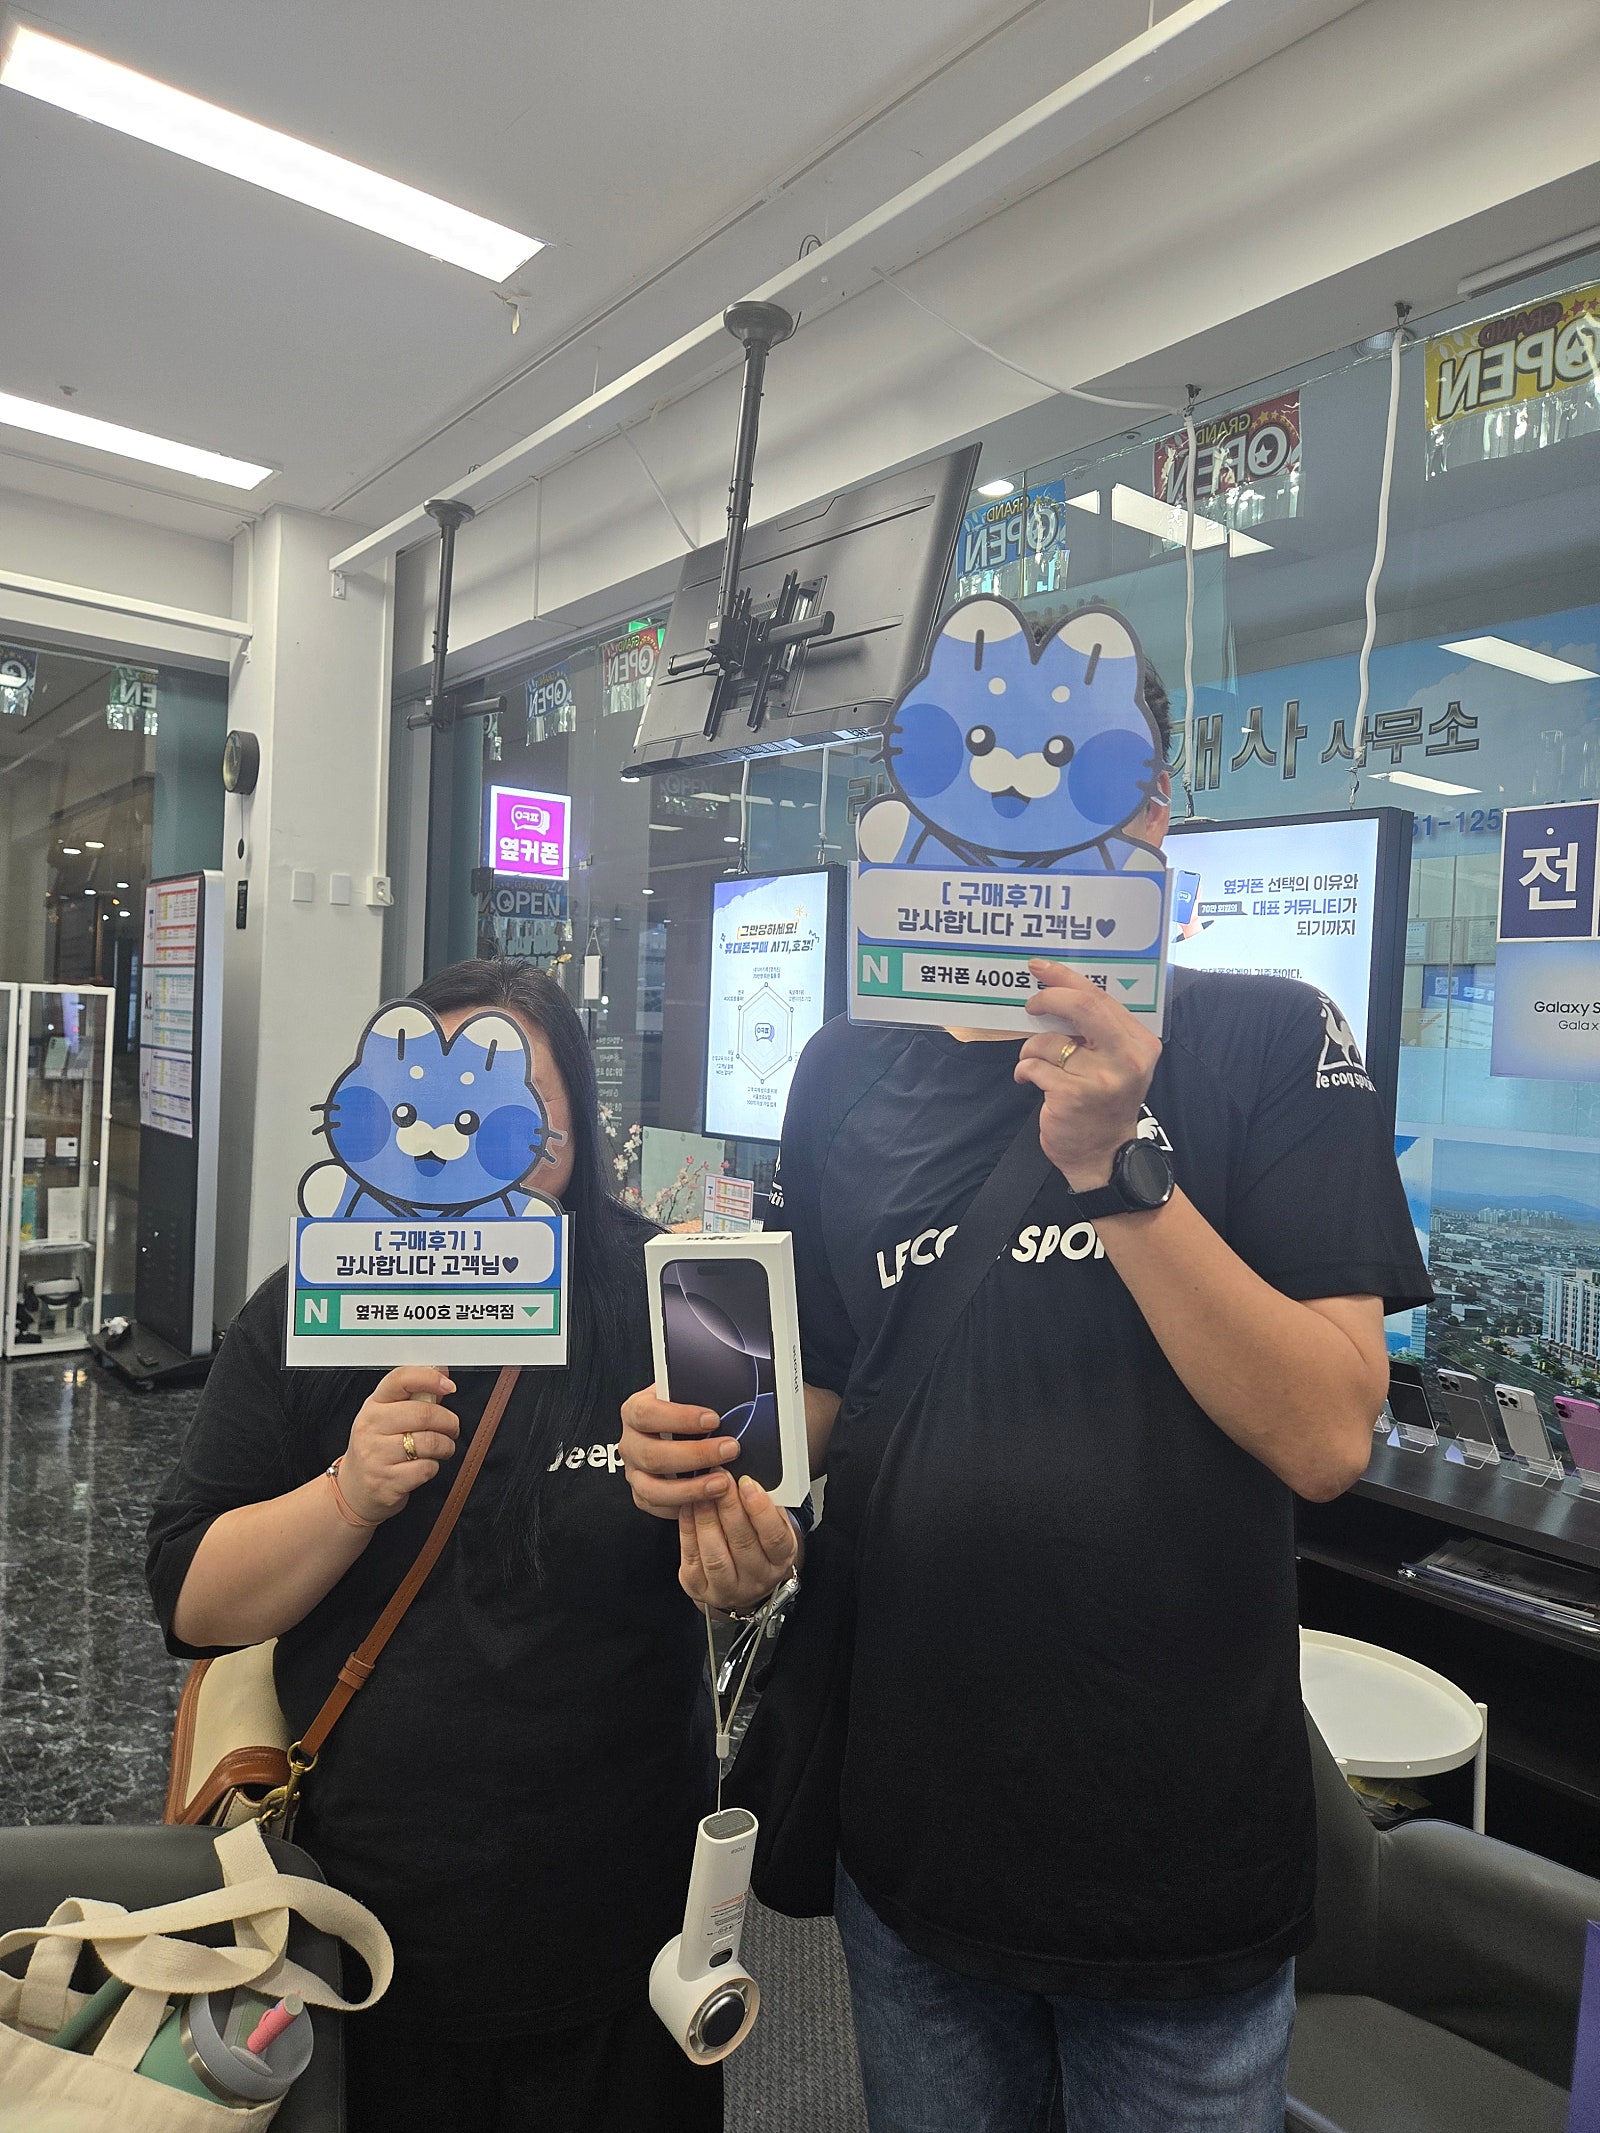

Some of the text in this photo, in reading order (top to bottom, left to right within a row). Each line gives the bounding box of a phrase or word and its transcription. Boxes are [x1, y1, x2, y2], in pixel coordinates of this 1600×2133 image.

[1321, 700, 1480, 767] 사무소
[499, 836, 560, 866] 옆커폰
[1223, 874, 1359, 894] 옆커폰 선택의 이유와
[1518, 842, 1578, 910] 전
[496, 890, 560, 916] OPEN
[958, 881, 1051, 909] 구매후기
[1253, 898, 1357, 916] 대표 커뮤니티가
[740, 922, 798, 937] 그만당하세요!
[897, 907, 1014, 936] 감사합니다
[1297, 919, 1356, 936] 되기까지
[862, 955, 889, 983] N
[920, 965, 970, 985] 옆커폰
[975, 969, 1031, 990] 400호
[1534, 1001, 1590, 1017] Galaxy
[1558, 1020, 1599, 1030] Galax
[1316, 1071, 1330, 1088] le
[1331, 1072, 1355, 1088] coq
[388, 1230, 466, 1251] 구매후기
[336, 1255, 436, 1276] 감사합니다
[304, 1298, 328, 1323] N
[356, 1304, 514, 1320] 옆커폰 400호 갈산역점
[547, 1441, 625, 1474] Jeep
